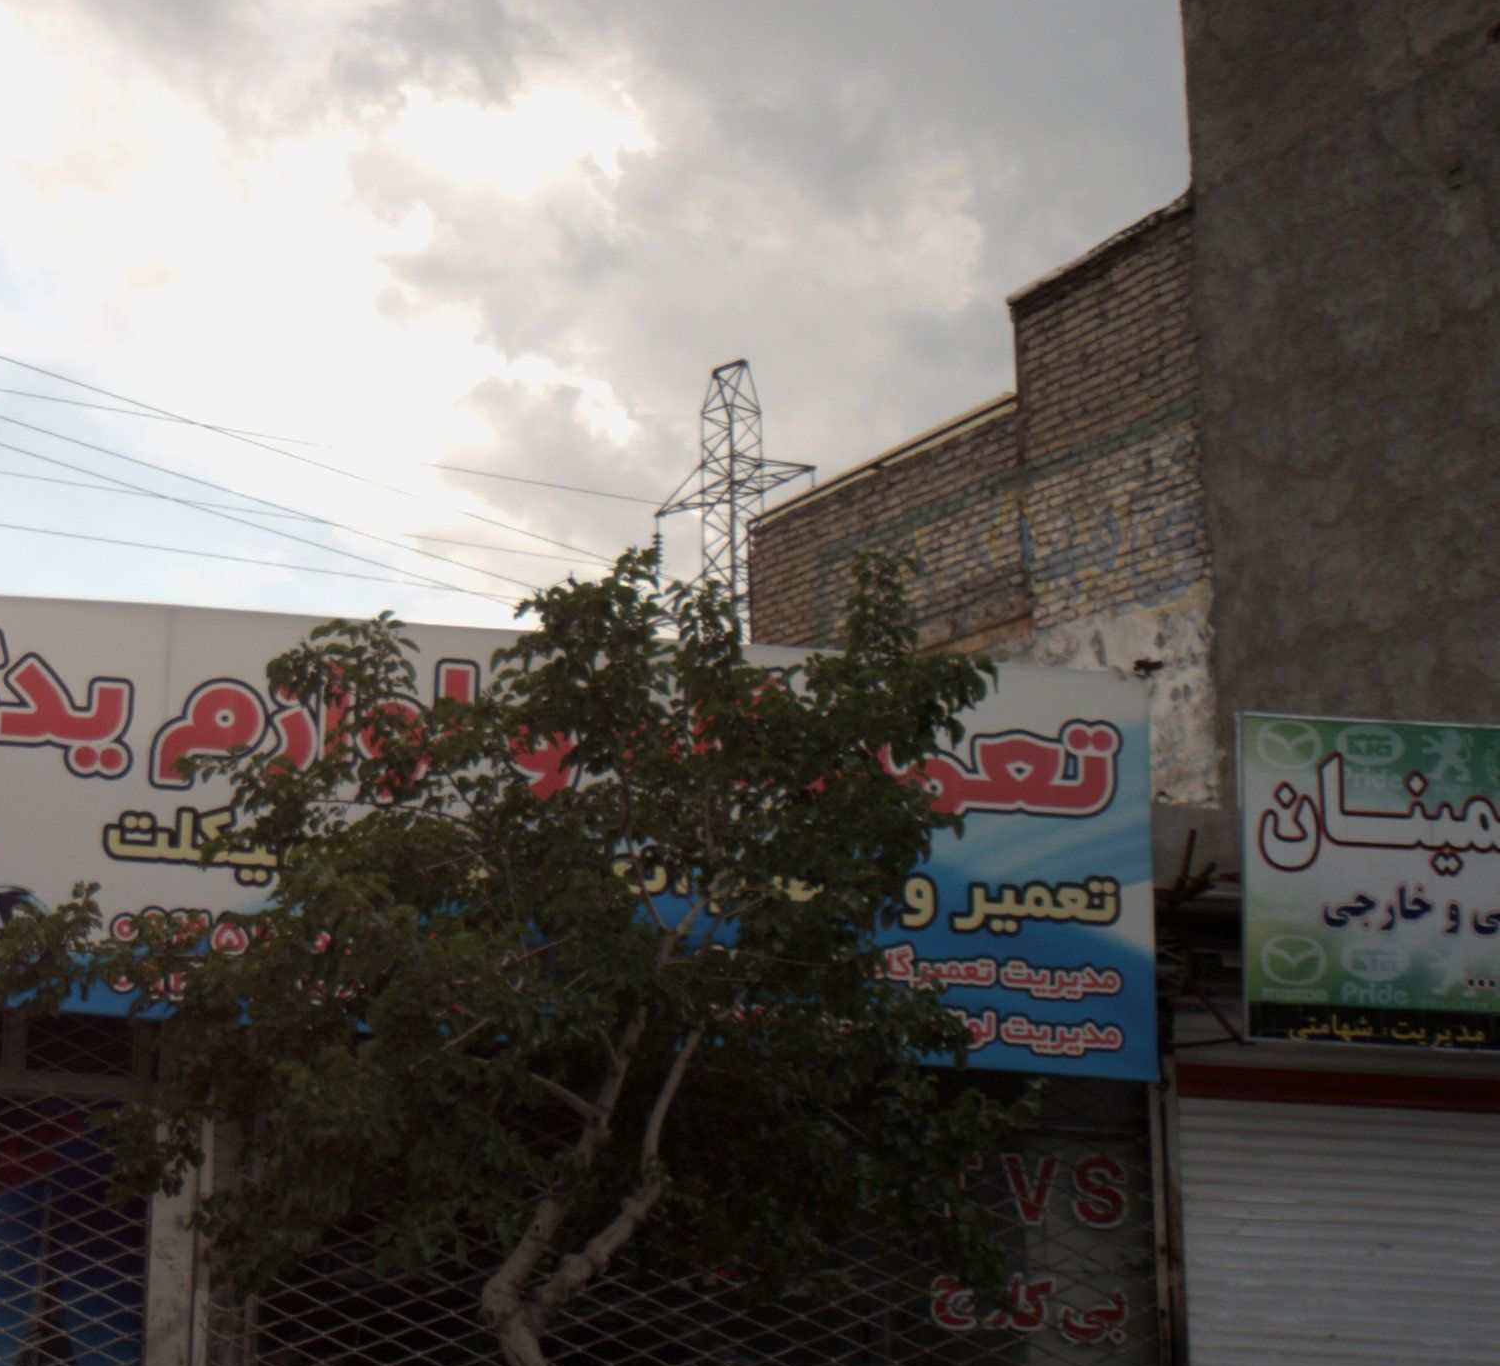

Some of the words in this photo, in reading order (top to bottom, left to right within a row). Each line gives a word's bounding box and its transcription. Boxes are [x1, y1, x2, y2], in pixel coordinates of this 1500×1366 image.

[1258, 750, 1500, 876] مینان
[103, 807, 312, 887] یکلت
[899, 874, 938, 929] و
[951, 875, 1121, 935] تعمیر
[1323, 885, 1433, 932] خارجی
[1001, 956, 1124, 1001] مدیریت
[1002, 1012, 1124, 1057] مدیریت
[930, 1153, 1129, 1229] VS
